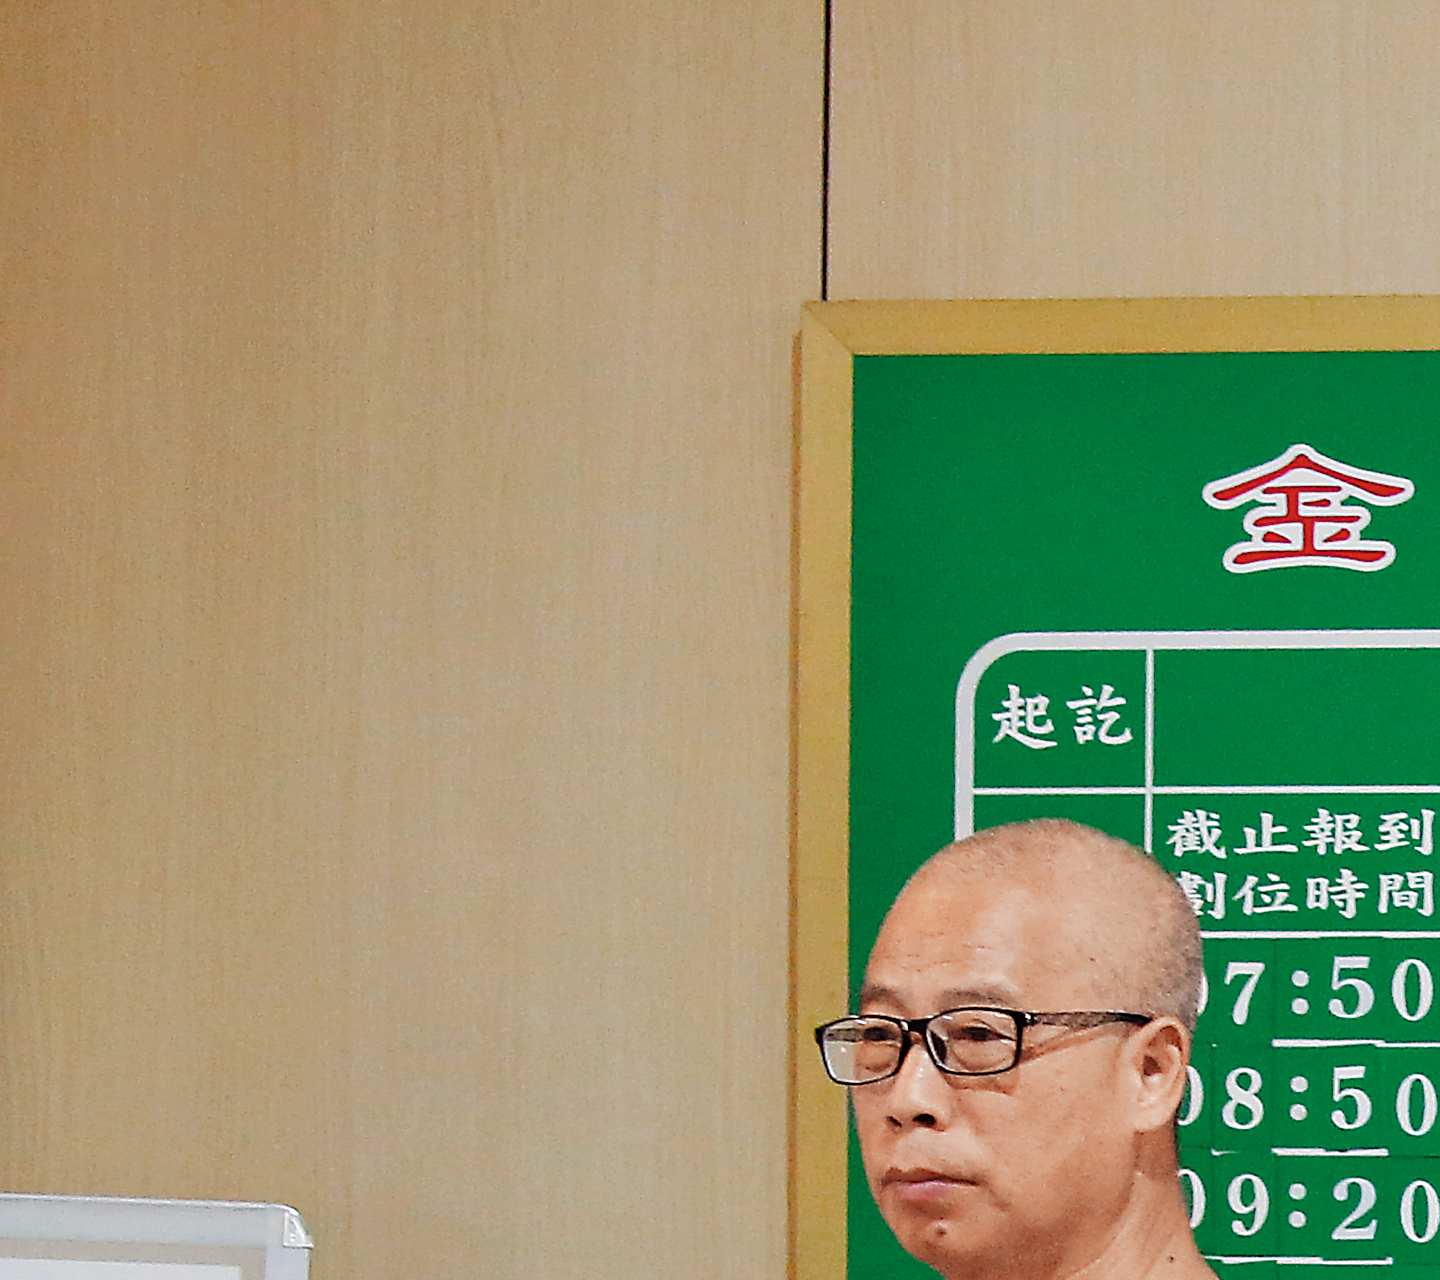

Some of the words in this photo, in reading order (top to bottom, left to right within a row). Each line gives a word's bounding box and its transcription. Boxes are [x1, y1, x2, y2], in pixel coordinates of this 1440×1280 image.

[992, 685, 1132, 749] 起訖
[1167, 808, 1436, 860] 截止報到
[1198, 957, 1435, 1023] 7:50
